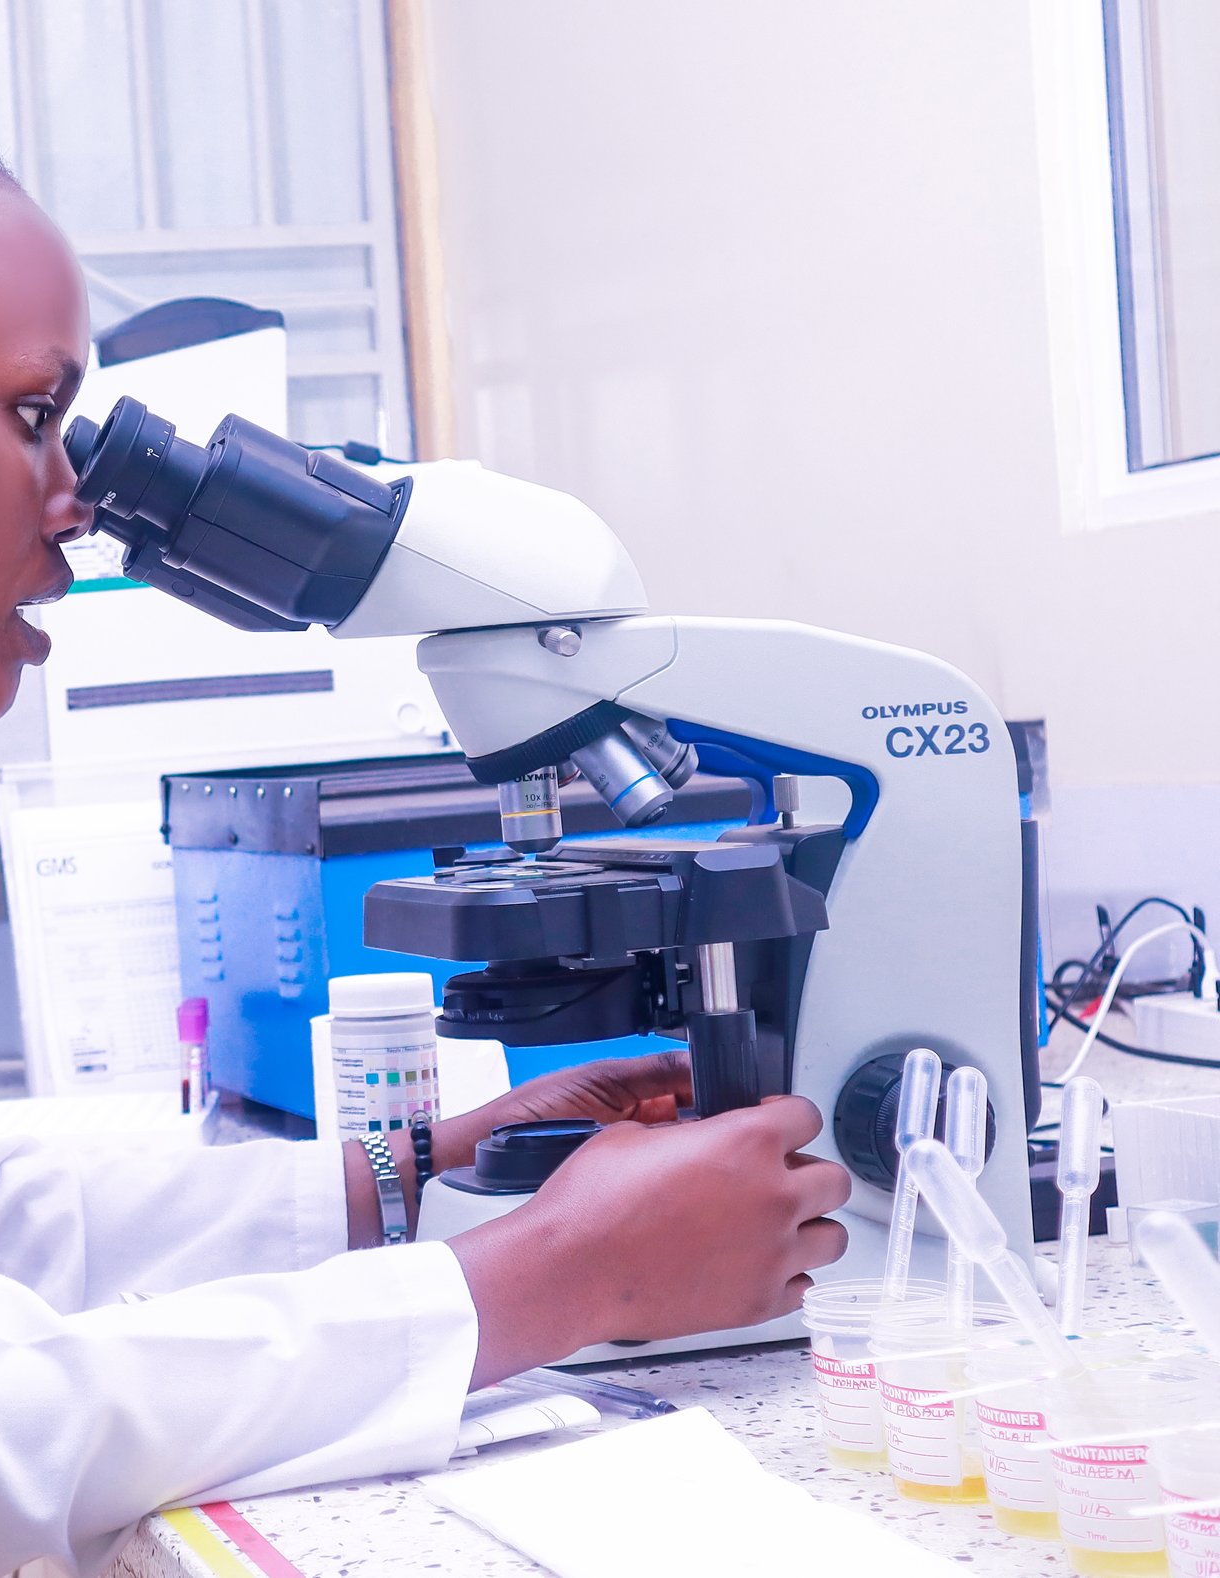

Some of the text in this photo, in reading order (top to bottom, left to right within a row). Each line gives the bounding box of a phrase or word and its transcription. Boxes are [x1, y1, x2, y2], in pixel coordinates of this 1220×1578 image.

[861, 700, 969, 720] OLYMPUS
[885, 722, 991, 758] CX23
[515, 773, 556, 783] OLYMPU
[525, 794, 542, 802] 10x
[814, 1356, 871, 1376] CONTAINER
[978, 1405, 1040, 1426] CONTAINER
[1064, 1446, 1146, 1461] CONTAINER
[1086, 1530, 1108, 1541] Time
